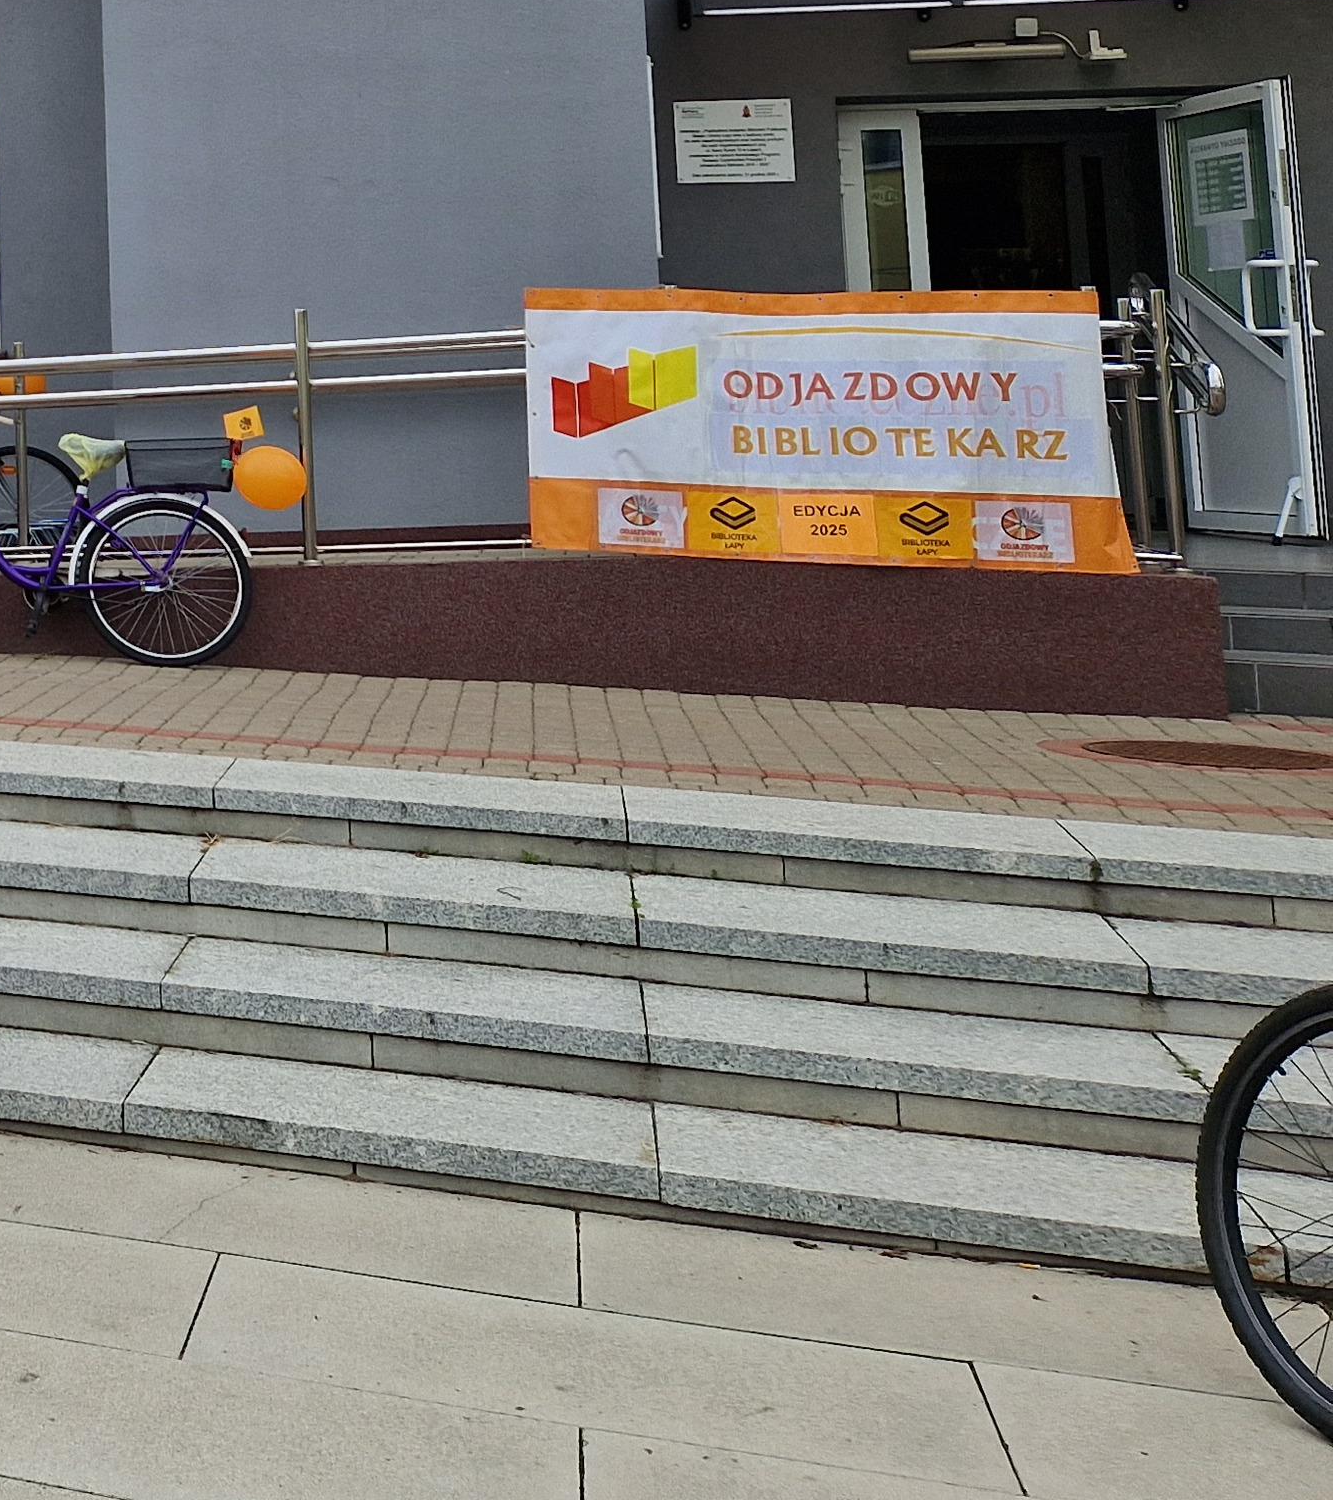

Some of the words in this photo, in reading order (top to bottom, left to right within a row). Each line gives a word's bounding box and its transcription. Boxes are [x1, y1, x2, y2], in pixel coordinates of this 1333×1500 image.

[722, 369, 1018, 407] ODJAZDOWY
[732, 425, 1069, 461] BIBLIOTEKARZ
[793, 504, 861, 517] EDYCJA
[810, 524, 848, 536] 2025
[711, 532, 758, 542] BIBLIOTEKA
[901, 537, 951, 547] BIBLIOTEKA
[724, 541, 746, 550] ŁAPY
[916, 547, 939, 556] ŁAPY
